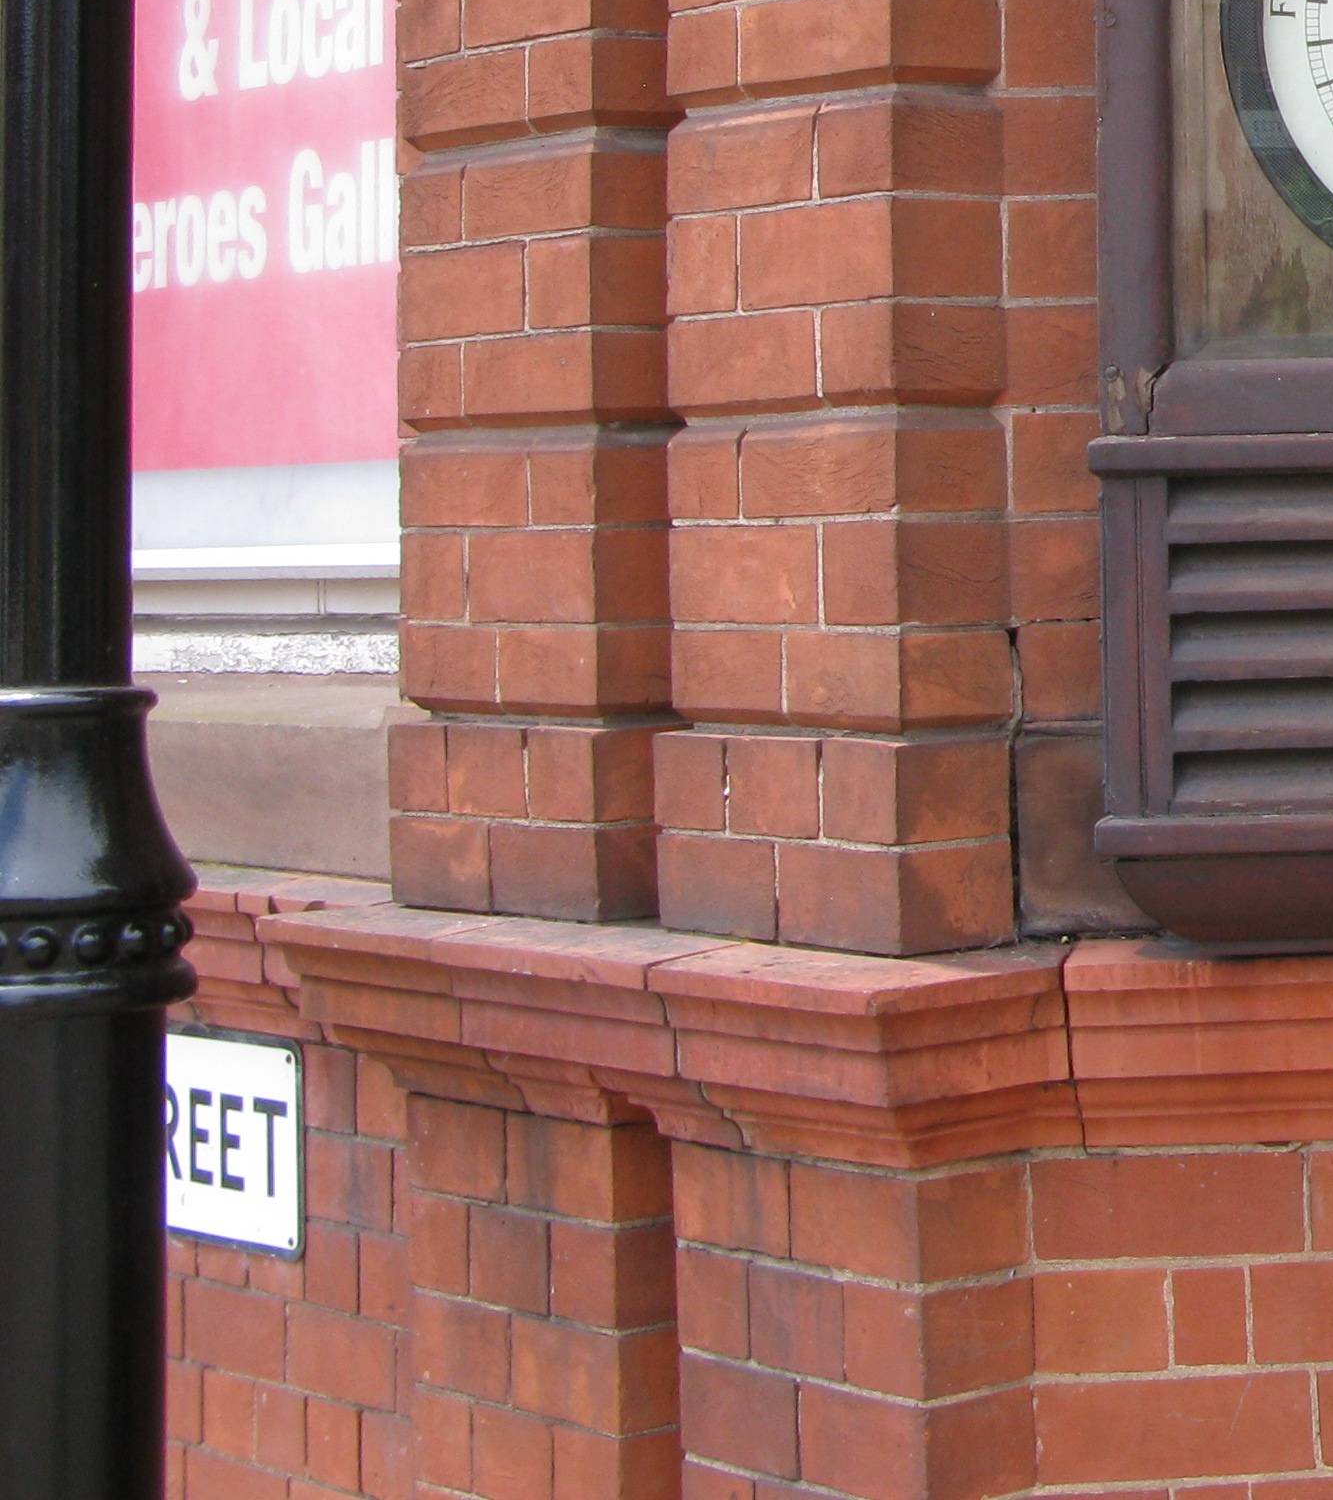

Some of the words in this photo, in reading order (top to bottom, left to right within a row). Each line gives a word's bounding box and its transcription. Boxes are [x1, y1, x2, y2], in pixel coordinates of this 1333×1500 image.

[133, 185, 268, 293] eroes
[289, 137, 396, 274] Gall
[165, 1082, 288, 1198] REET
